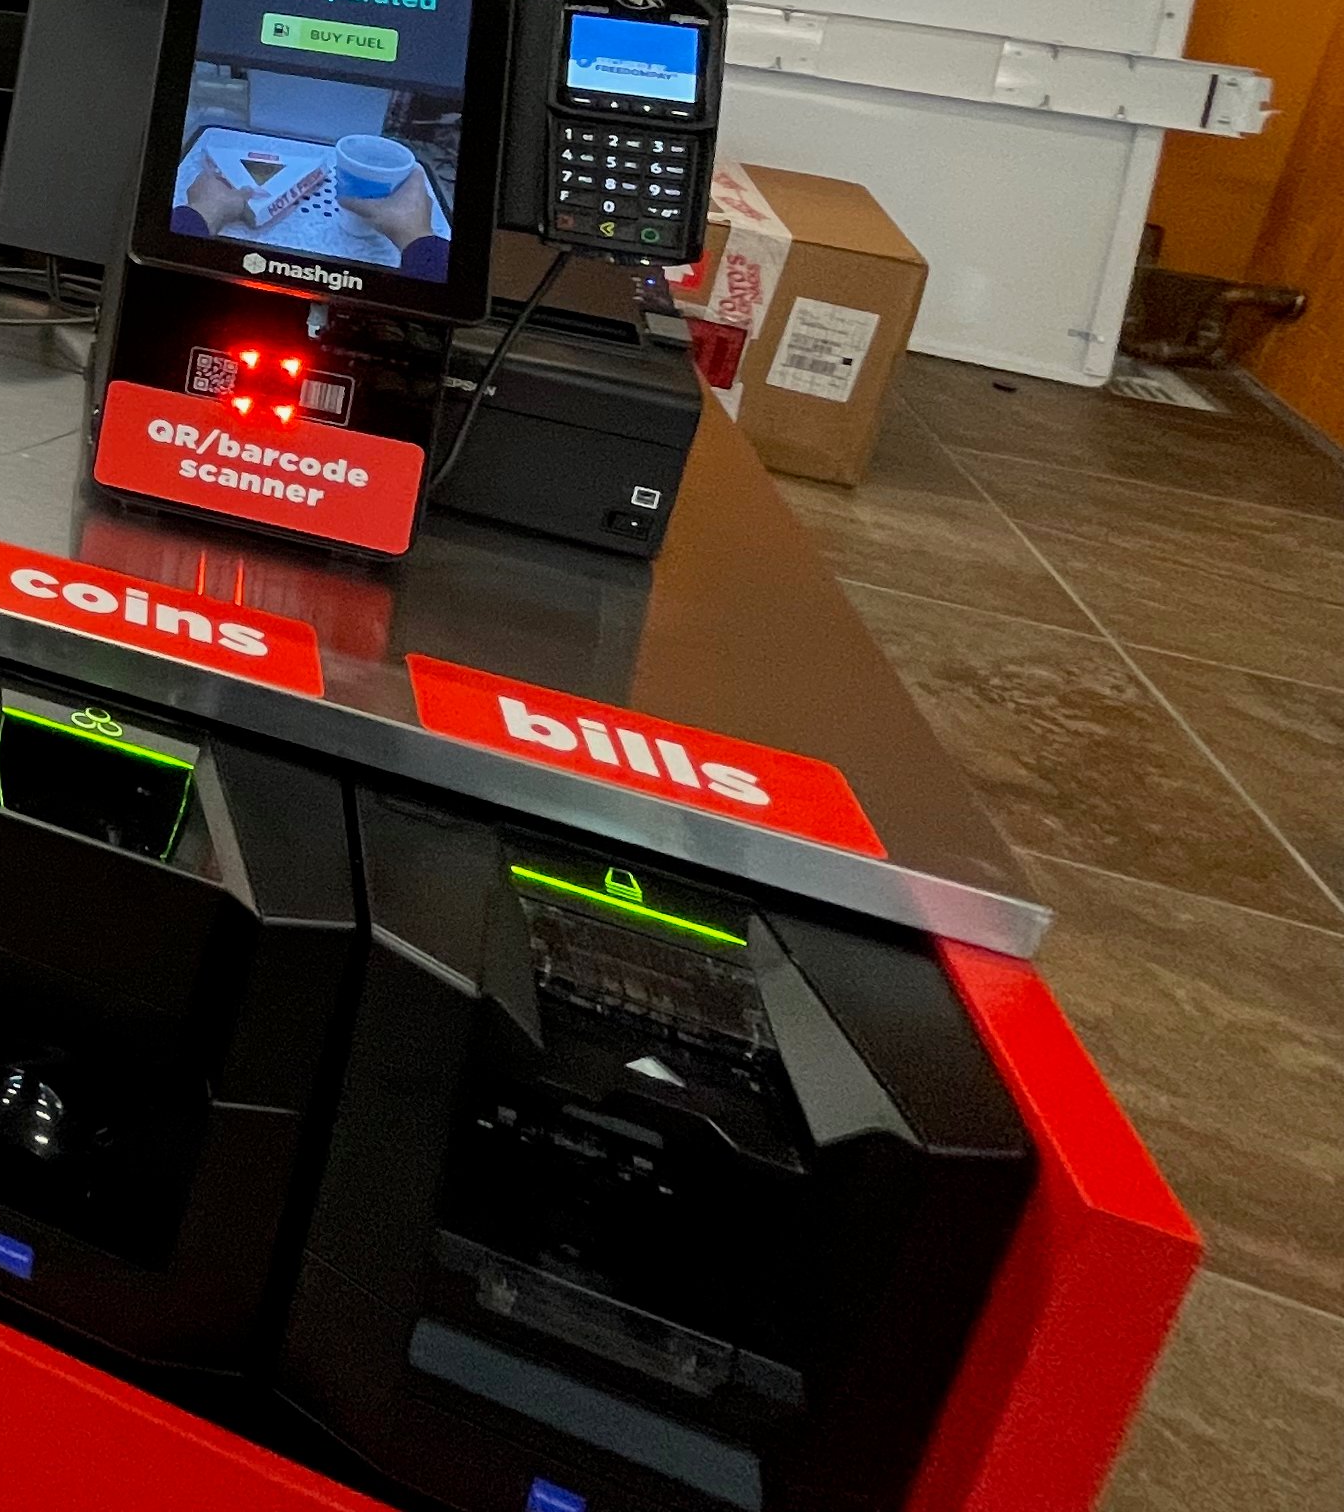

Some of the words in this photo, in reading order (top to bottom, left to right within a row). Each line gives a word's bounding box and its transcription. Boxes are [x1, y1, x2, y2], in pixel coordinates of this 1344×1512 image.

[309, 28, 342, 45] BUY
[346, 33, 386, 52] FUEL
[564, 127, 573, 140] 1
[608, 134, 619, 148] 2
[652, 140, 664, 153] 3
[561, 148, 573, 161] 4
[605, 155, 617, 169] 5
[649, 162, 662, 175] 6
[561, 170, 573, 183] 7
[604, 178, 617, 191] 8
[648, 184, 661, 197] 9
[268, 259, 364, 292] mashgin
[146, 417, 370, 489] QR/barcode
[178, 456, 326, 508] scanner
[9, 568, 270, 659] coins
[497, 694, 774, 810] bills
